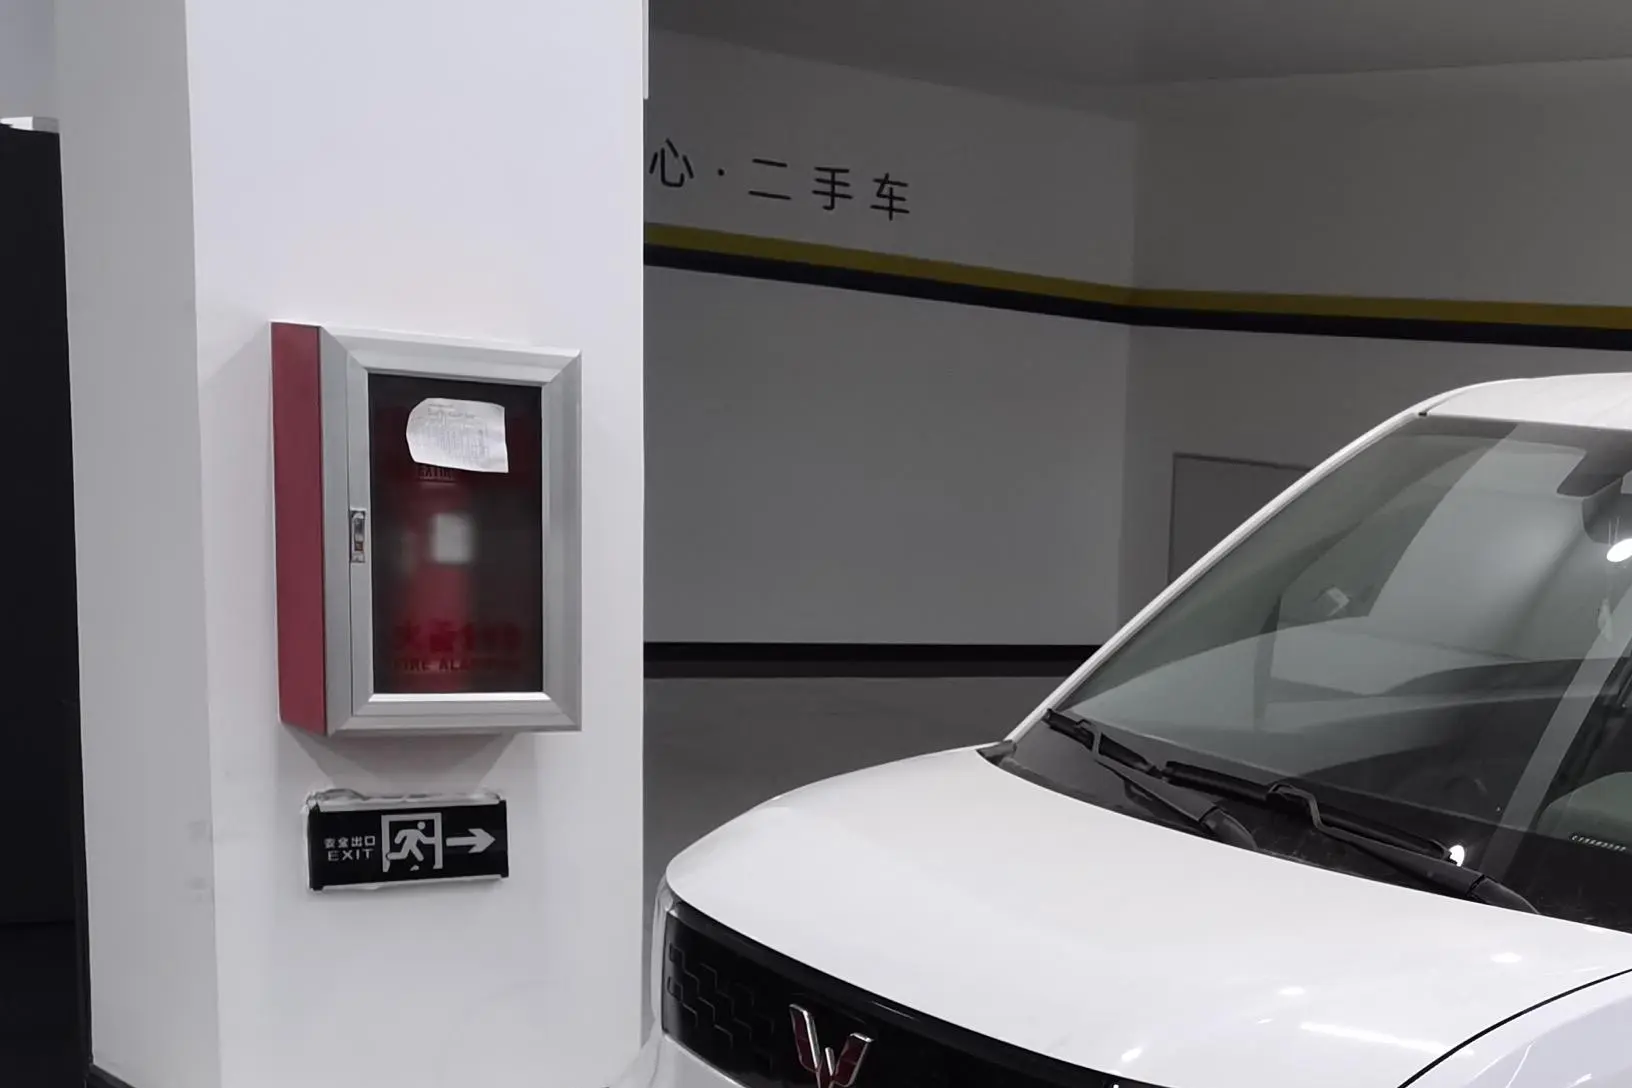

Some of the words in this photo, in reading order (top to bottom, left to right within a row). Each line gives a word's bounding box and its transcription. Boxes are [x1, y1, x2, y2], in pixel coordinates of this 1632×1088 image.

[324, 836, 376, 848] 安全出口
[328, 848, 374, 861] EXIT
